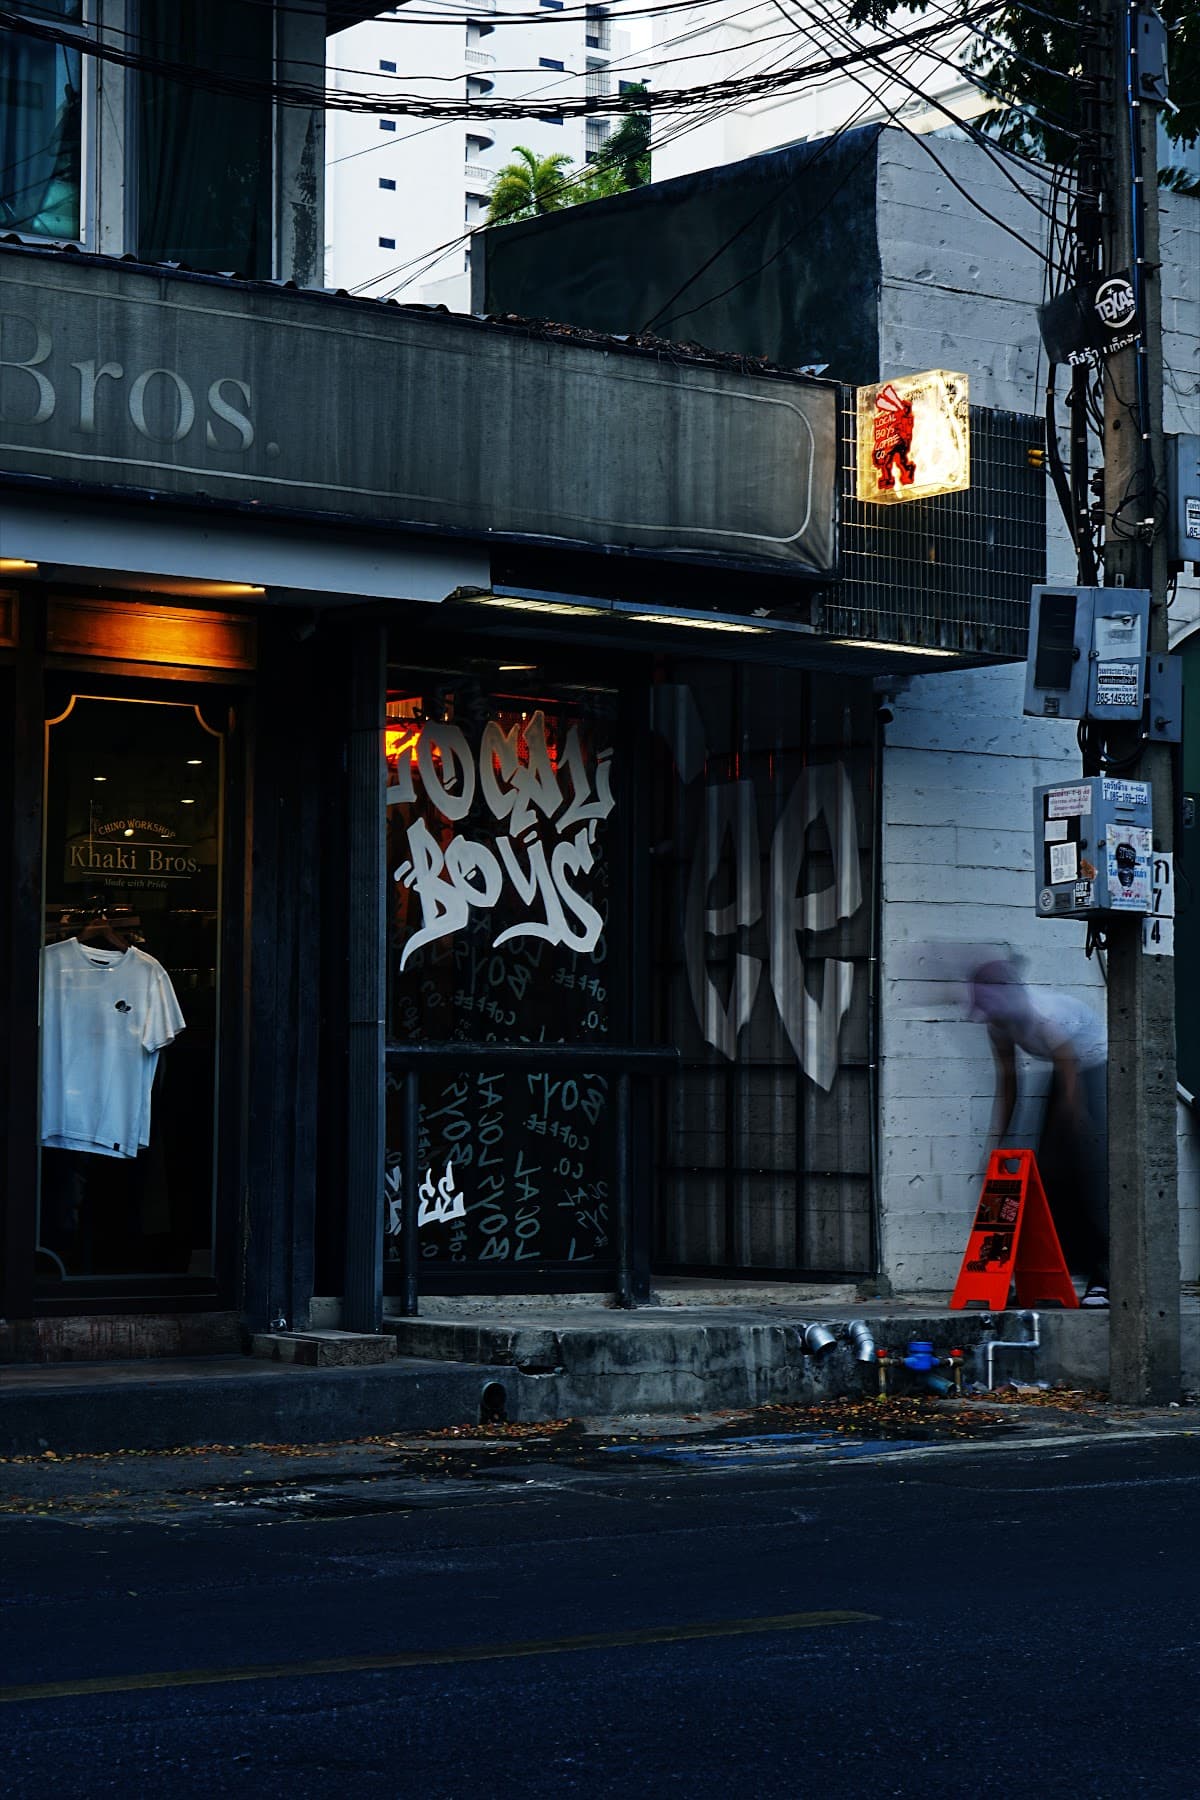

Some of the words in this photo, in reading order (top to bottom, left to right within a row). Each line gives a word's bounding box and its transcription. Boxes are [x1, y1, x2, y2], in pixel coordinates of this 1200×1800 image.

[1094, 286, 1135, 321] TEXAS
[0, 315, 282, 459] Bros.
[875, 414, 897, 428] LOCAL
[875, 425, 895, 440] BOYS
[98, 820, 125, 836] CHINO
[127, 818, 177, 839] WORKSHOP
[70, 846, 137, 870] Khaki
[148, 850, 202, 873] Bros.
[147, 879, 169, 890] Pride
[392, 817, 603, 972] BOYS
